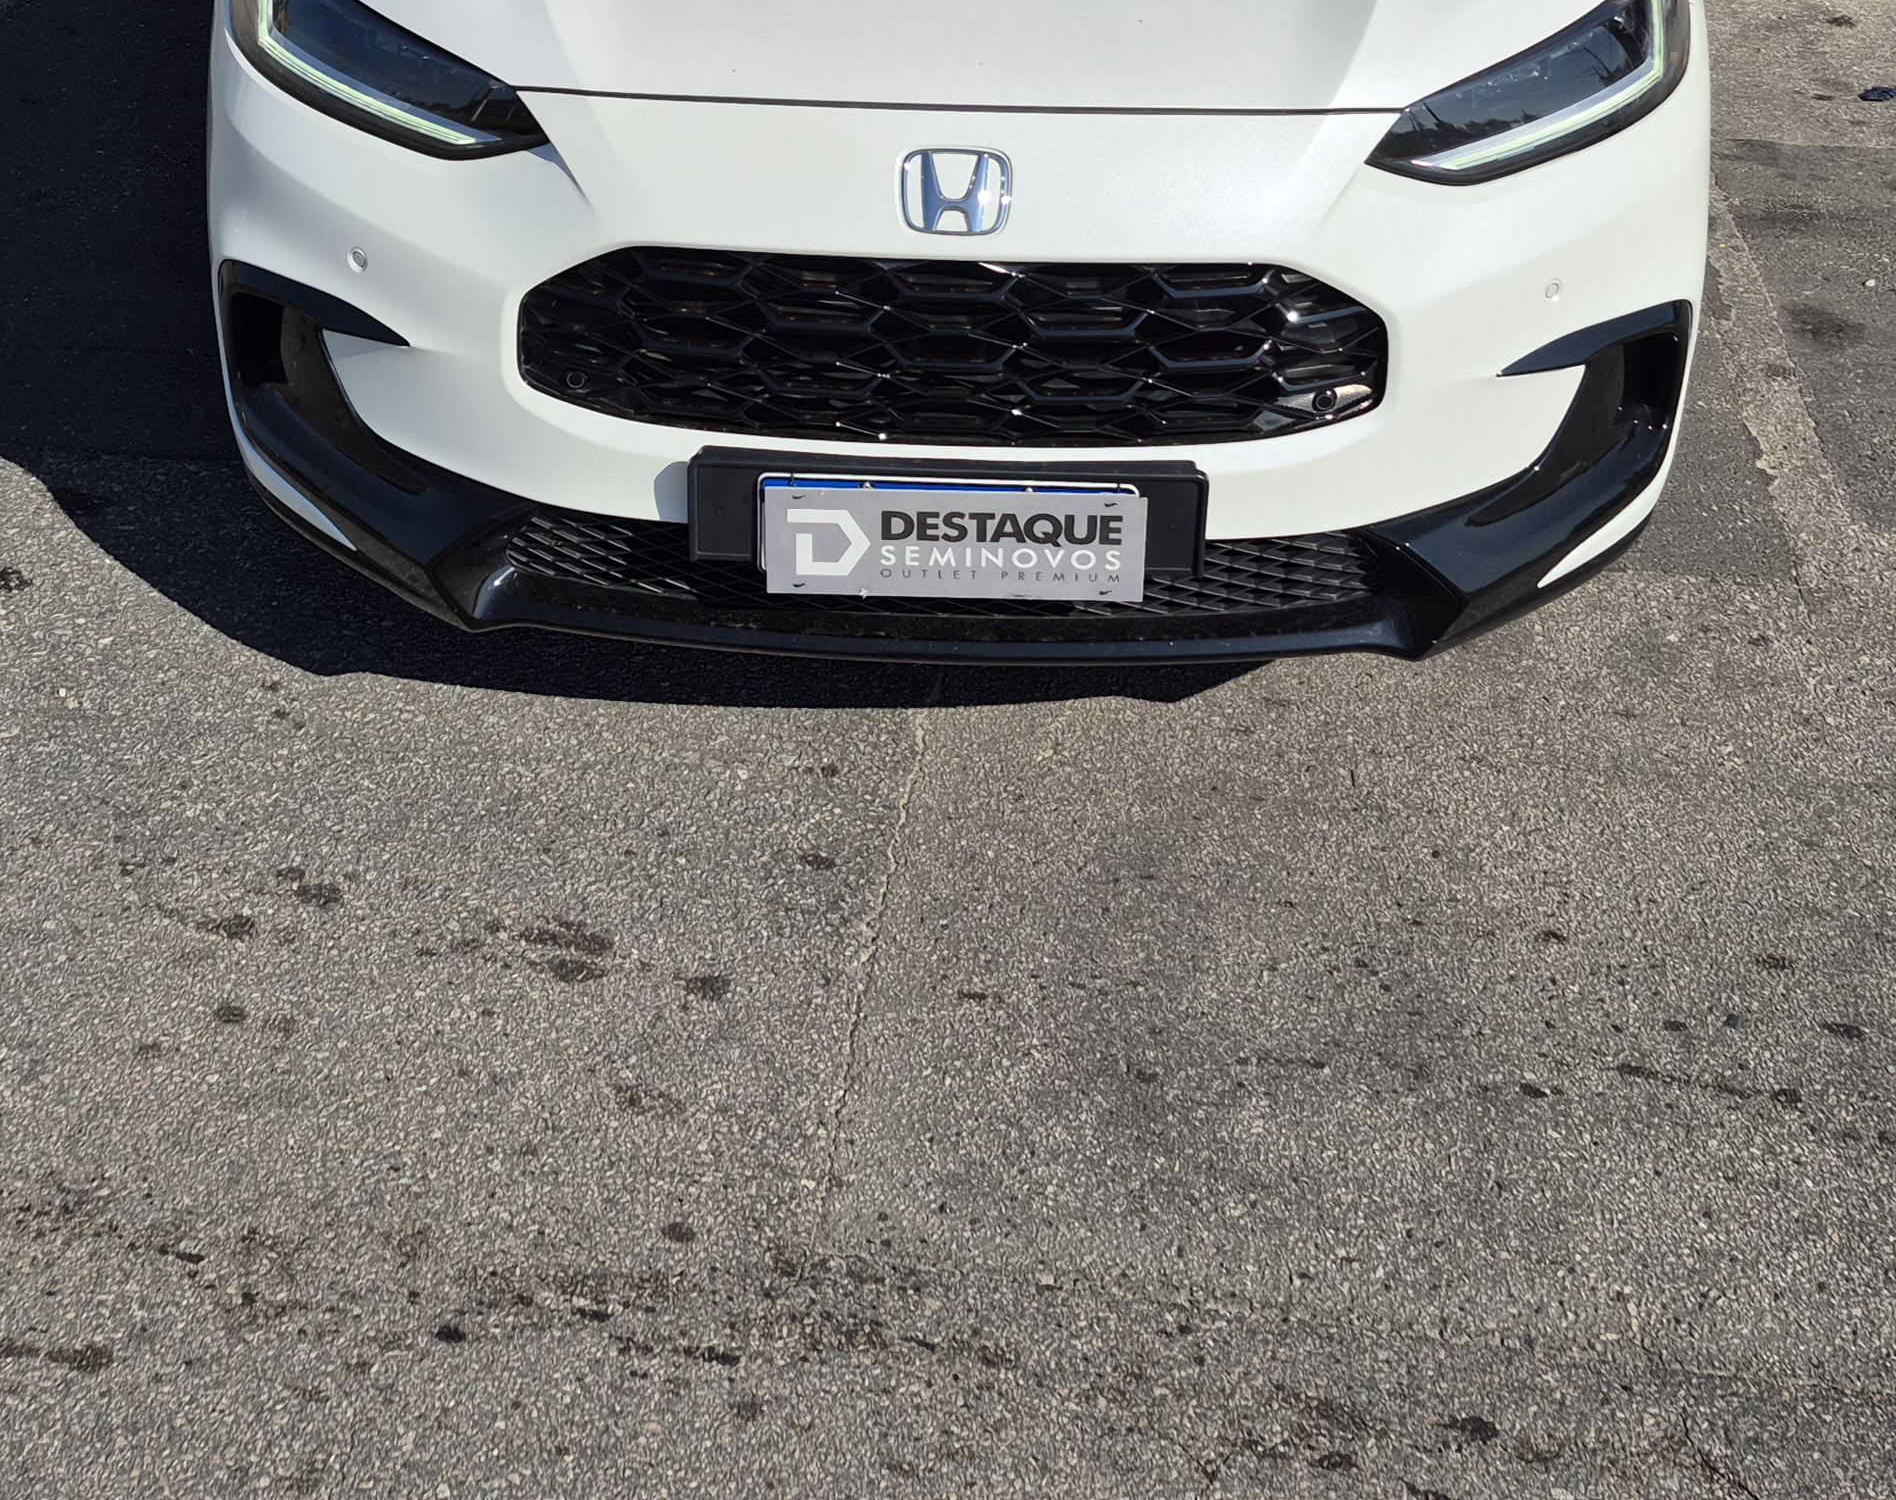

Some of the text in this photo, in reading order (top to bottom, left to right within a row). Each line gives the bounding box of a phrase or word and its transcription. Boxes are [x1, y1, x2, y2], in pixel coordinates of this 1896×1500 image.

[880, 509, 1124, 547] DESTAQUE
[879, 545, 1122, 571] SEMINOVOS
[880, 568, 1121, 583] OUTLET PREMIUM
